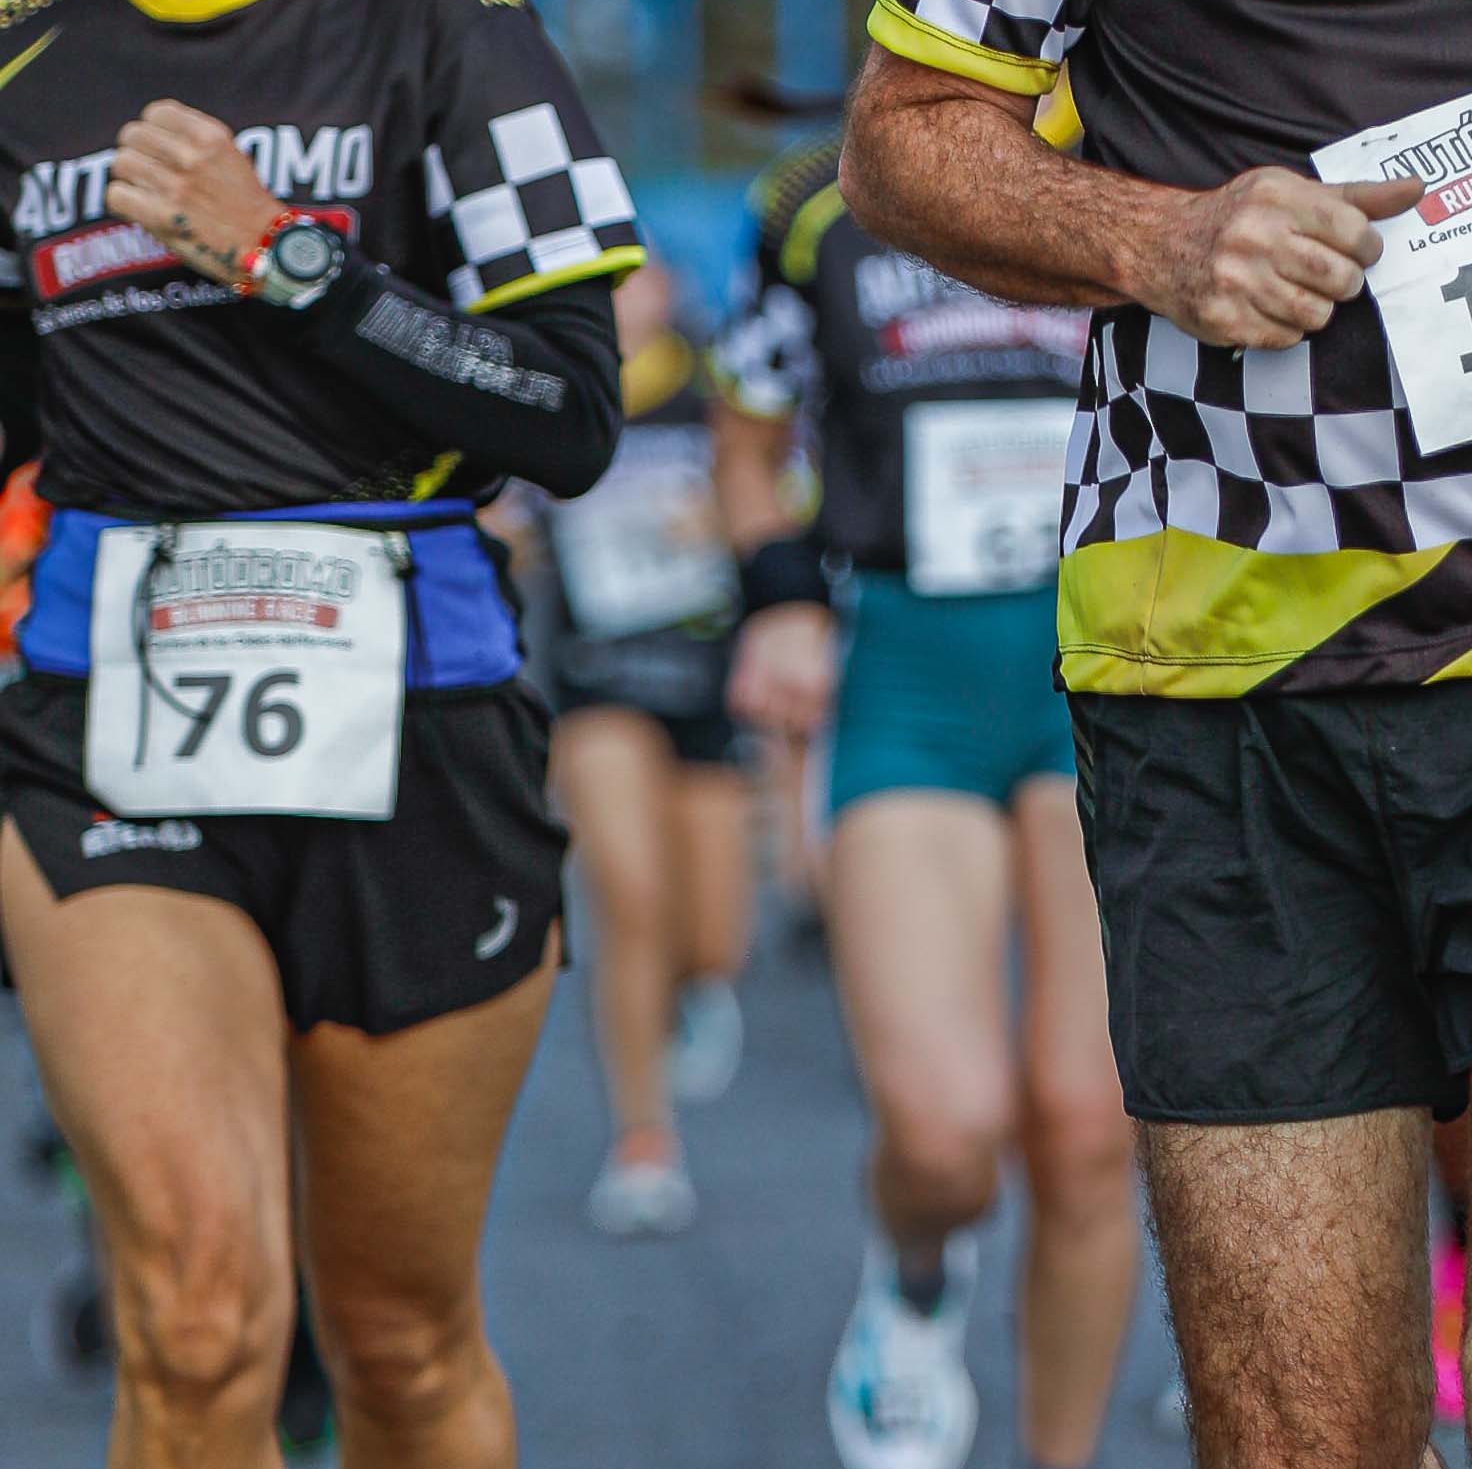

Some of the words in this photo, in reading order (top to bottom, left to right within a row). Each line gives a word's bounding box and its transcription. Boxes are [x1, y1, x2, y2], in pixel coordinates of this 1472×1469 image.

[12, 122, 375, 239] AUTOMO
[1408, 238, 1427, 253] La
[172, 668, 305, 761] 76
